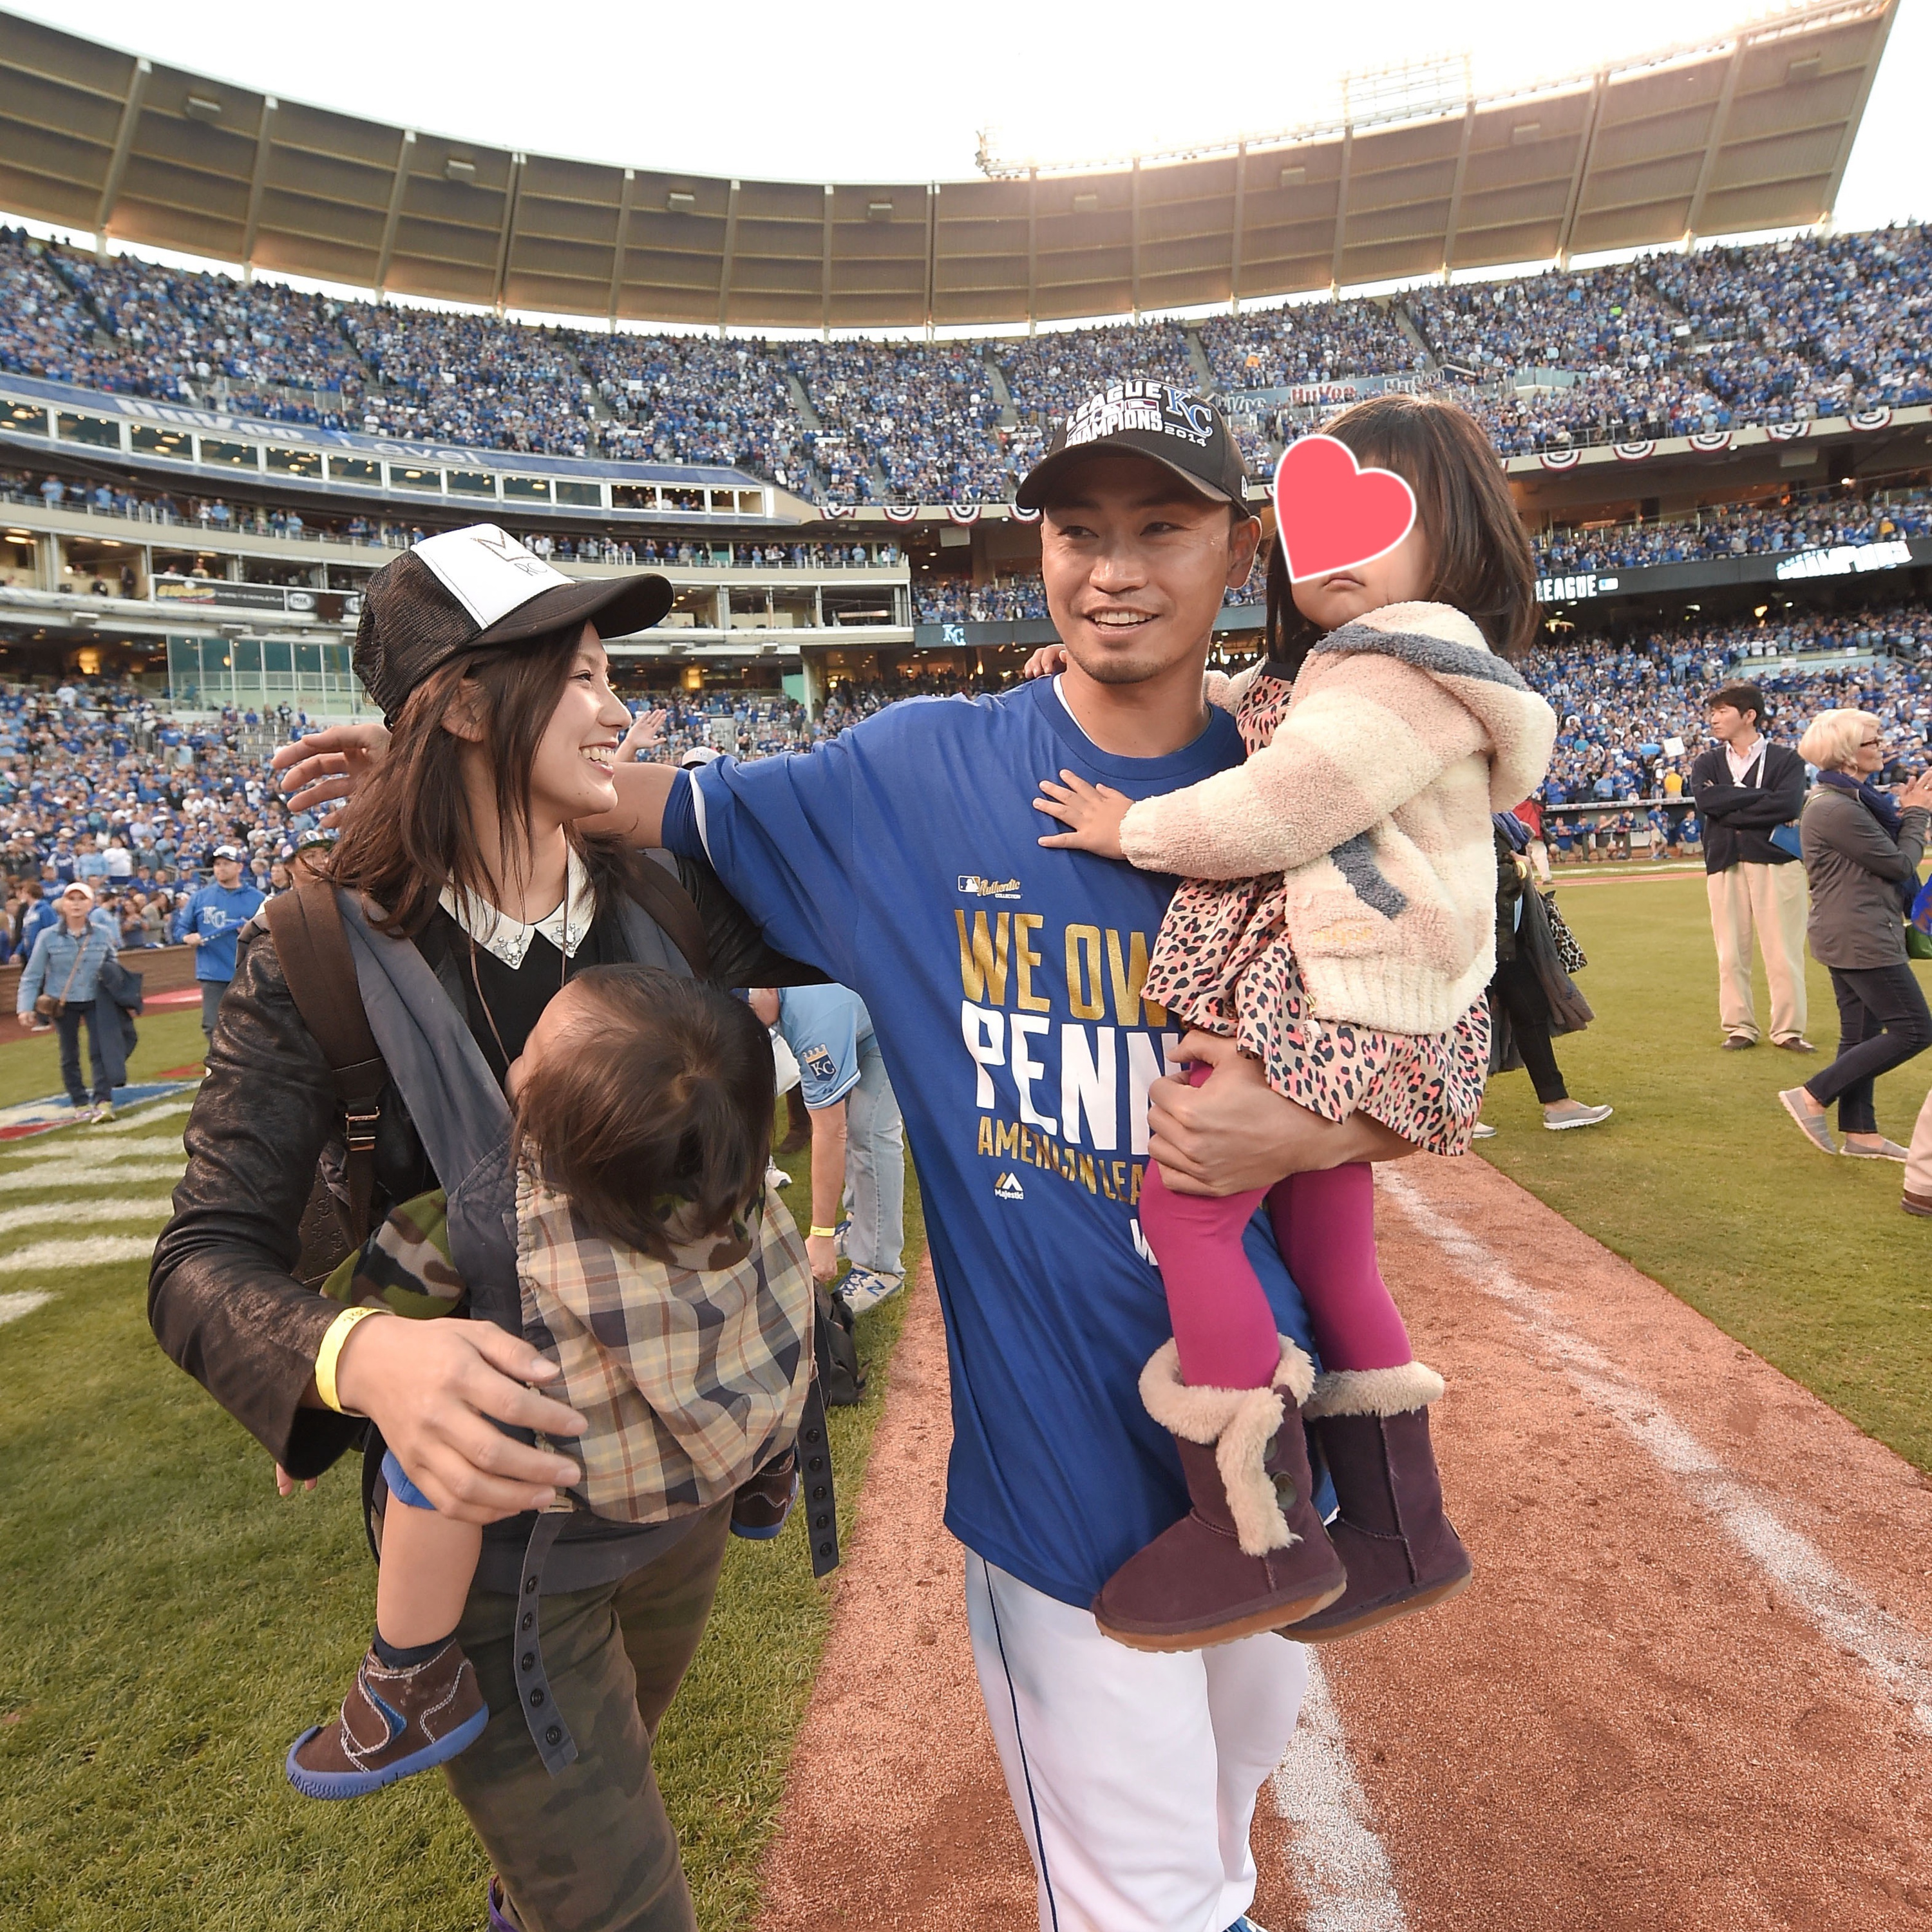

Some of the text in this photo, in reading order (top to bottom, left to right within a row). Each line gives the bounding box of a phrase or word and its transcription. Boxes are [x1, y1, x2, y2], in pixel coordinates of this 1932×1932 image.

[1066, 381, 1162, 432] LEAGUE
[1163, 386, 1213, 437] KC
[1164, 425, 1207, 447] 2014
[1535, 574, 1597, 601] LEAGUE
[942, 624, 966, 646] KC
[977, 878, 1020, 896] Authentic
[203, 906, 226, 928] KC
[954, 909, 1168, 1028] WE OW
[811, 1060, 835, 1076] KC
[961, 1000, 1182, 1155] PENN
[1099, 1160, 1144, 1205] LEA
